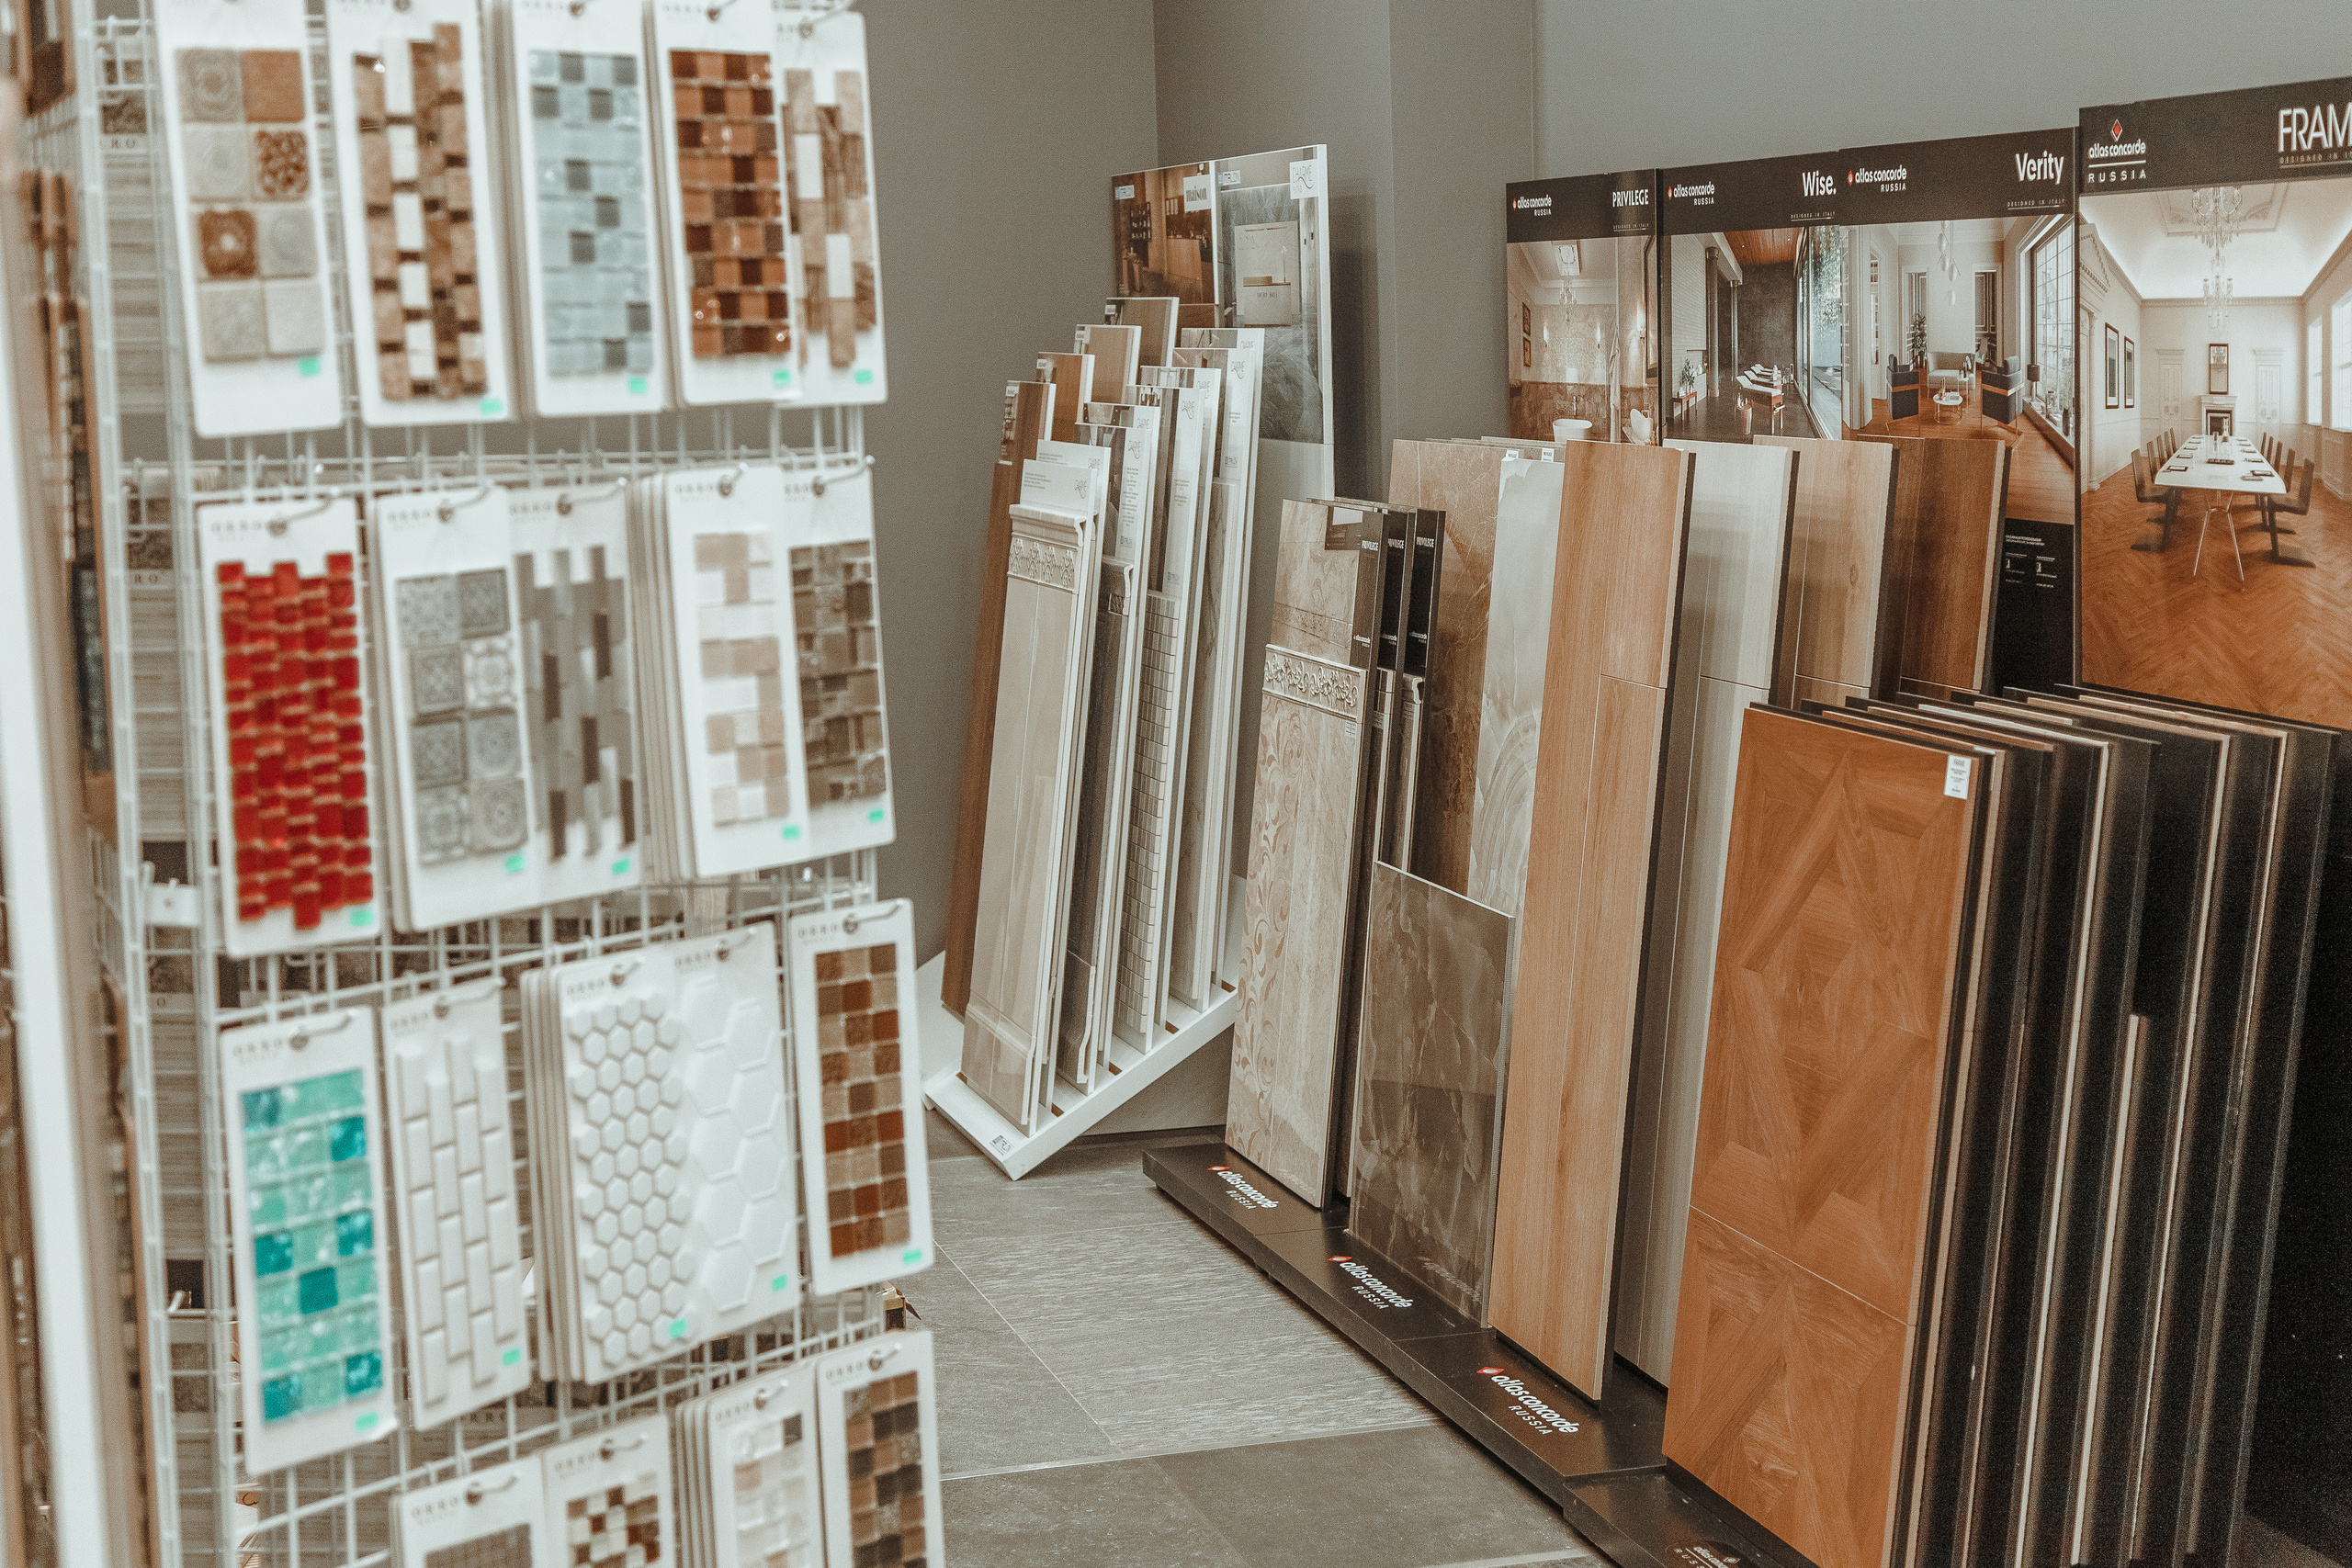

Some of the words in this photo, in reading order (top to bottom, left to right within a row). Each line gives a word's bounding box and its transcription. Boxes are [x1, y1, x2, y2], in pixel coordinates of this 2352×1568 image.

[2278, 101, 2352, 152] FRAM
[2015, 150, 2064, 185] Verity
[2088, 169, 2146, 183] RUSSIA
[1802, 170, 1837, 197] Wise.
[1881, 182, 1907, 192] RUSSIA
[1612, 189, 1649, 208] PRIVILEGE
[1694, 197, 1714, 206] RUSSIA
[1533, 209, 1552, 217] RUSSIA
[1225, 1190, 1257, 1210] RUSSIA
[1351, 1286, 1389, 1309] RUSSIA
[1508, 1405, 1553, 1435] RUSSIA
